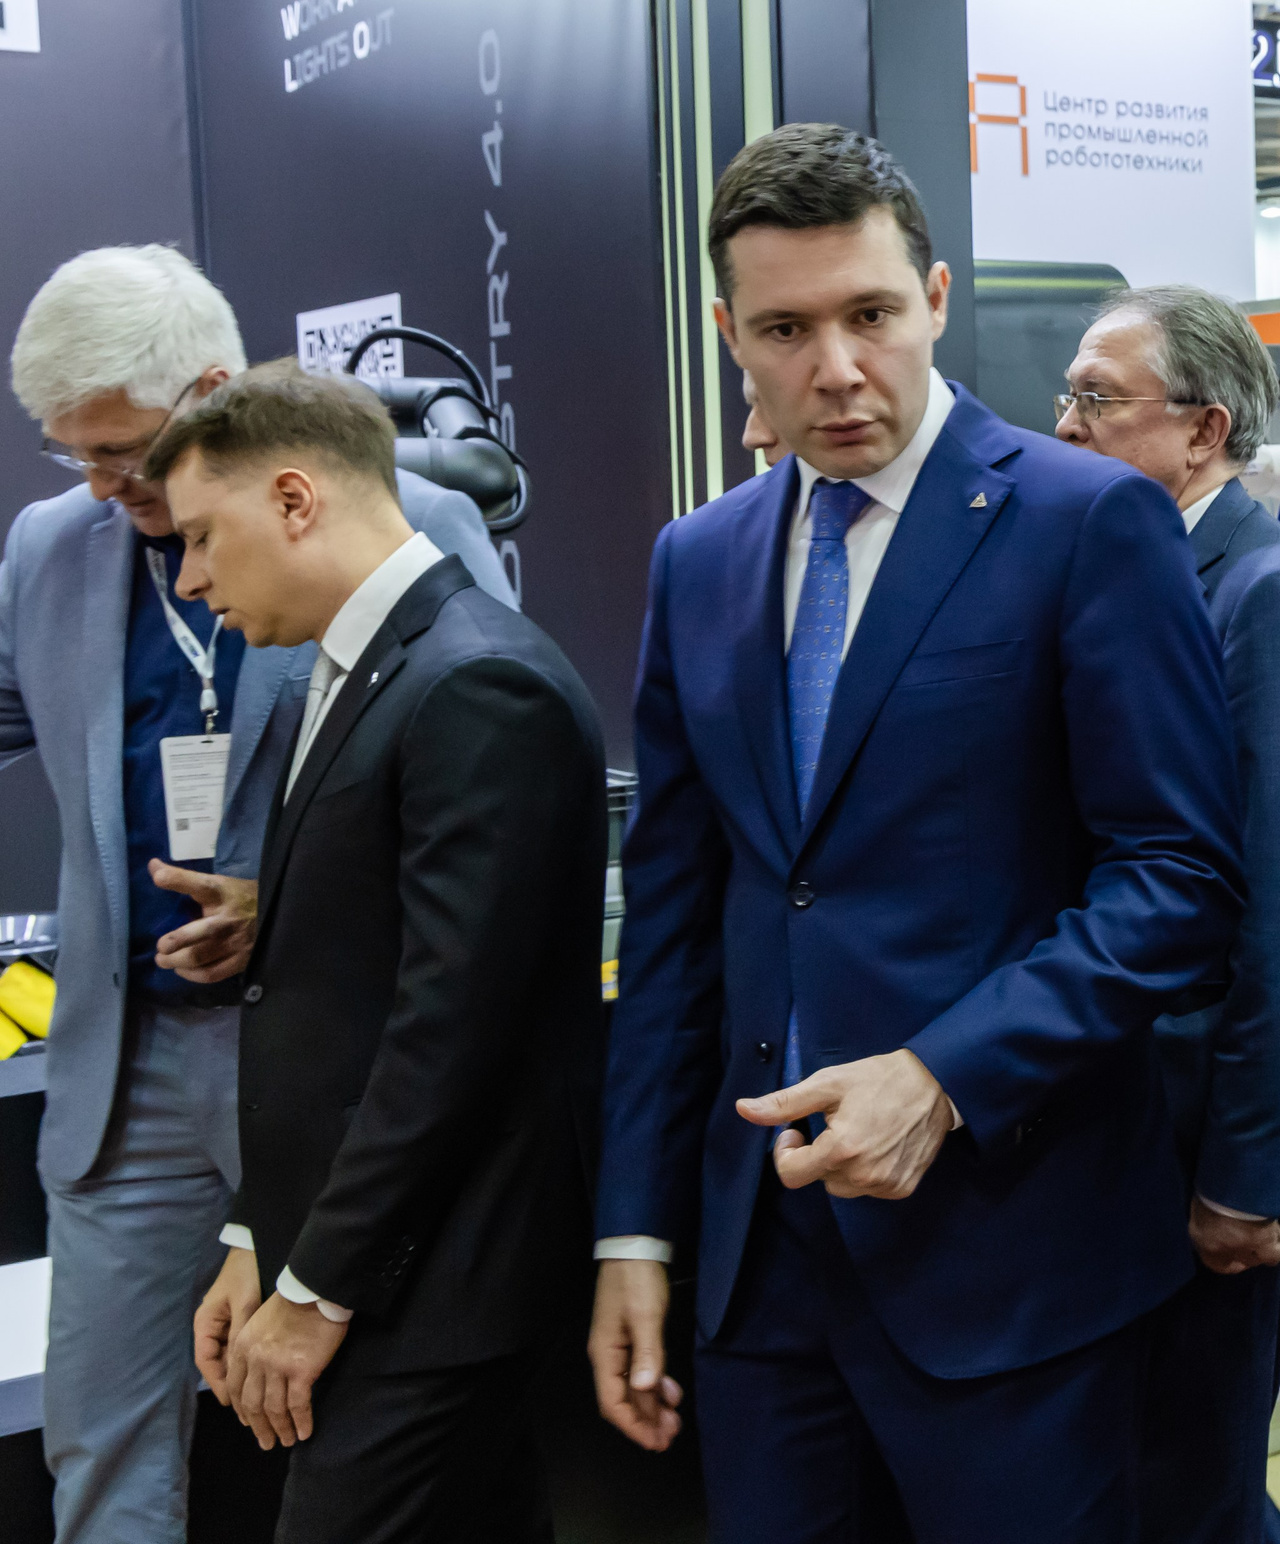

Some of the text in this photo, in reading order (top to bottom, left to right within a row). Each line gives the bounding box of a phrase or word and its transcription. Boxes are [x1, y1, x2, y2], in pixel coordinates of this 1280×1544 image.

[284, 7, 394, 93] LIGHTS OUT
[478, 28, 503, 187] 4.0
[1043, 91, 1209, 122] Центр развития
[1045, 122, 1209, 147] промышленной
[1045, 147, 1203, 173] робототехники
